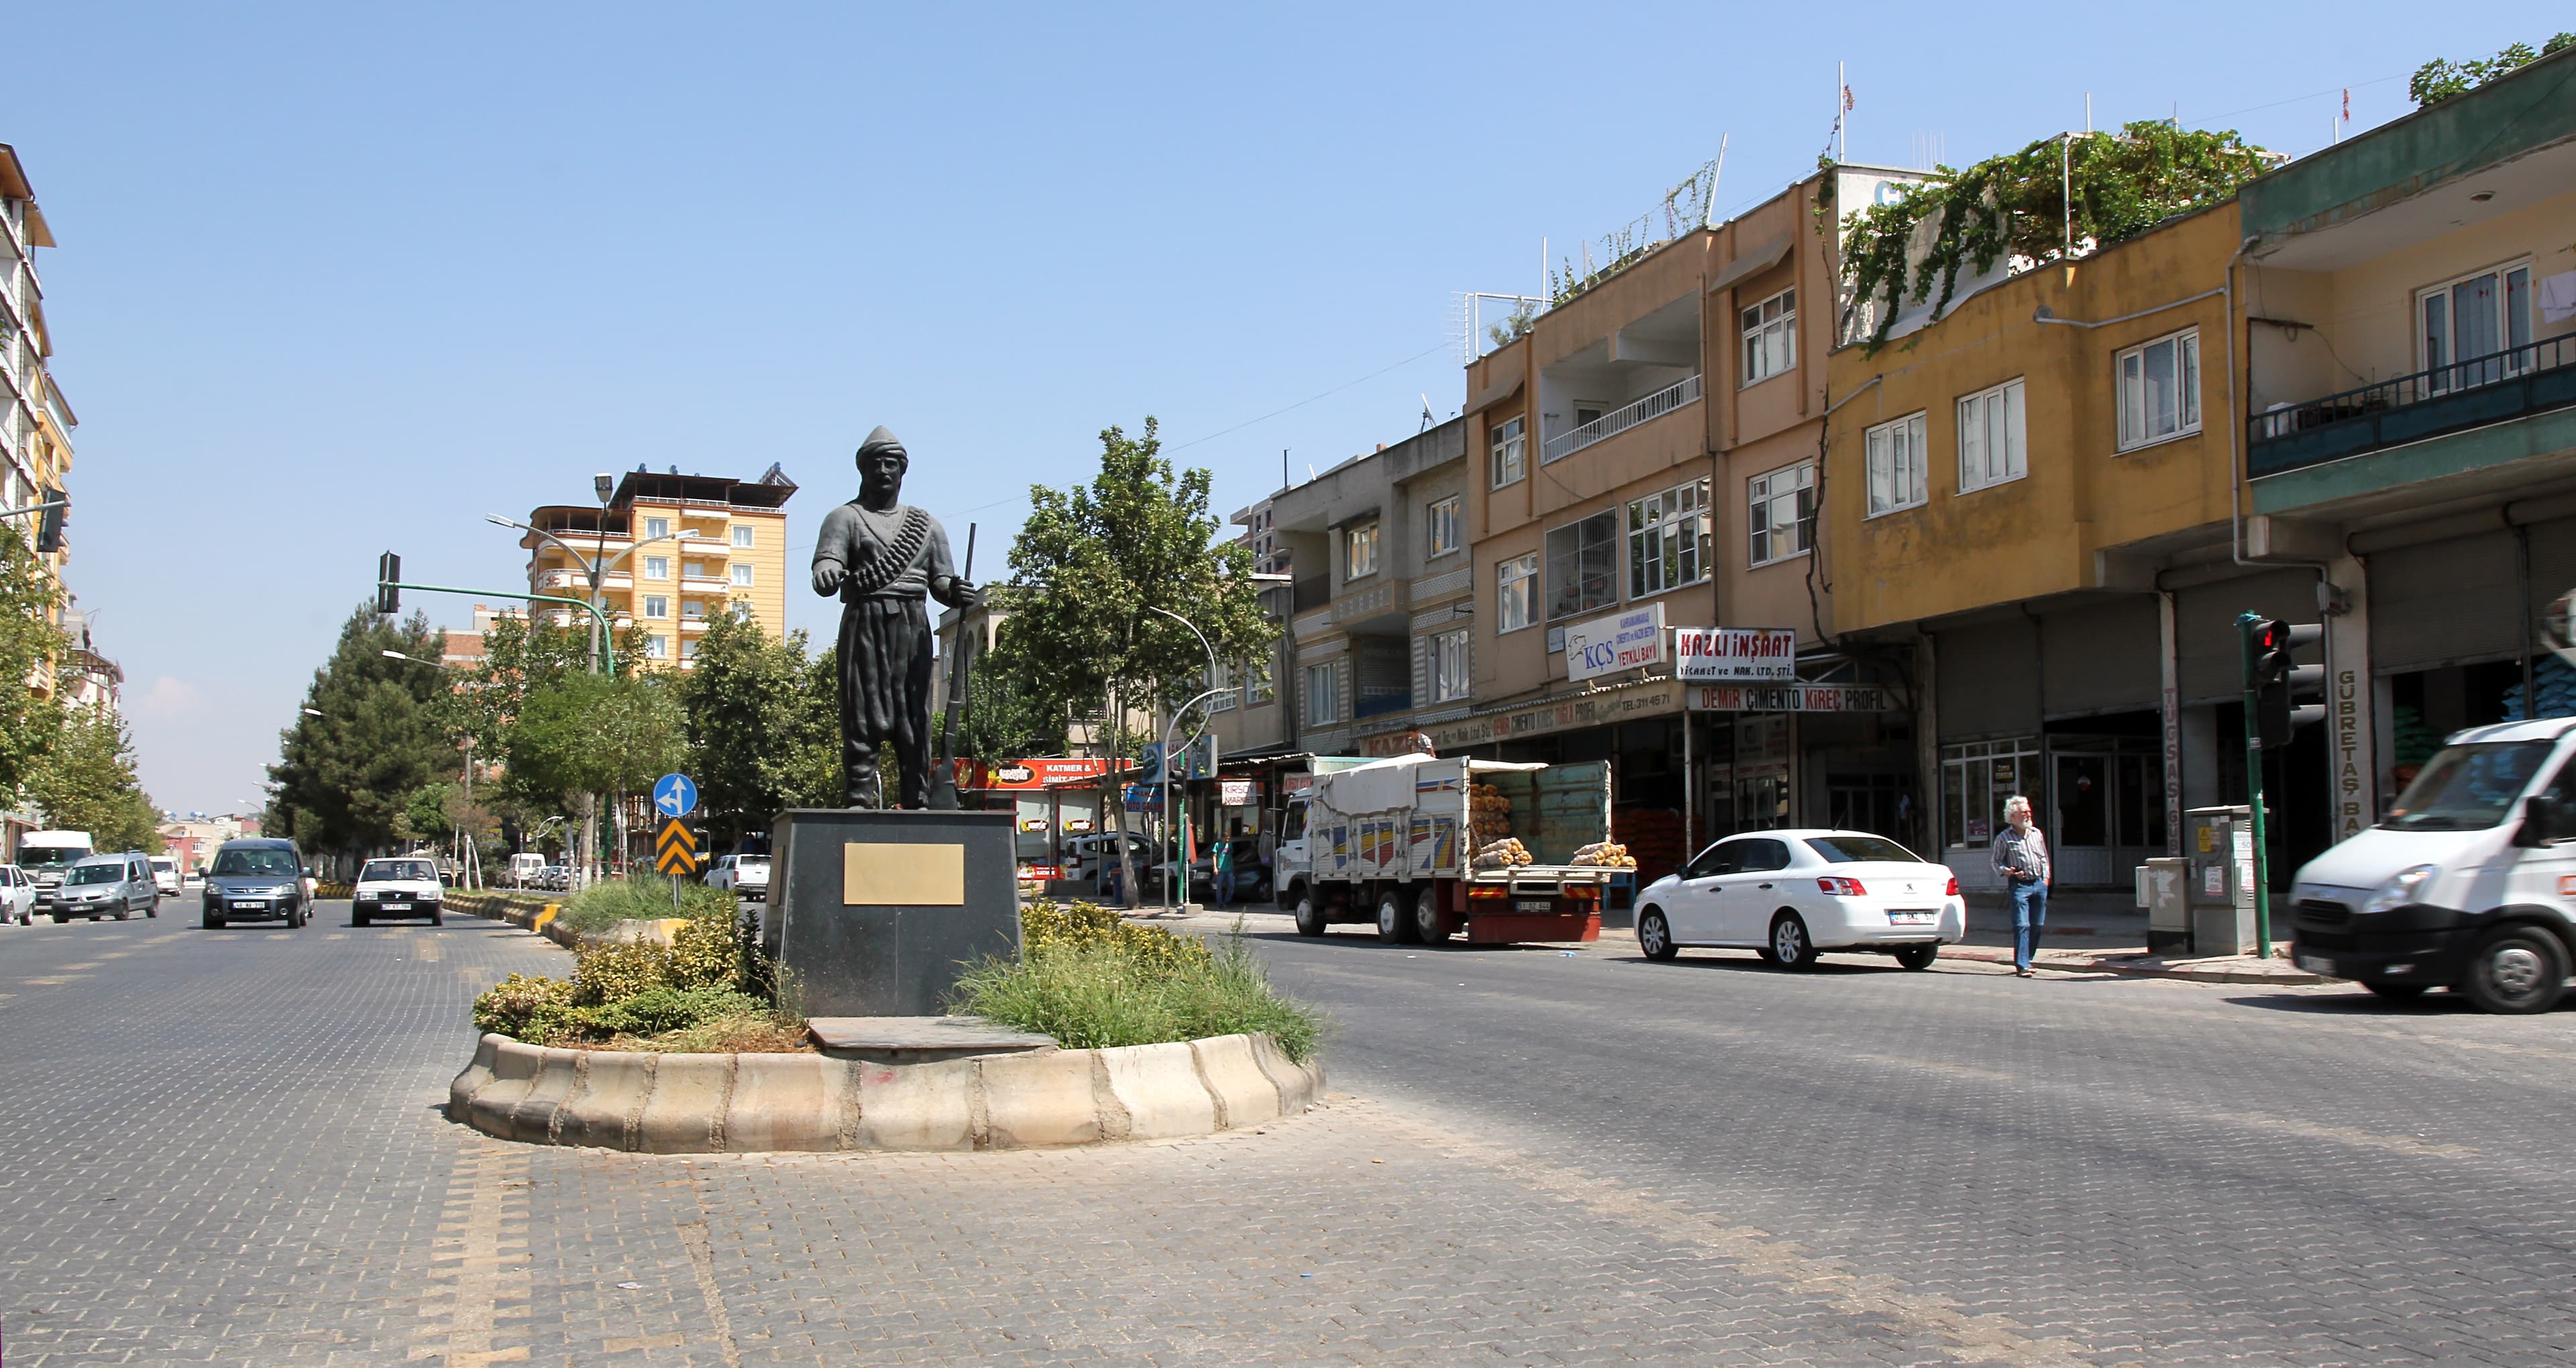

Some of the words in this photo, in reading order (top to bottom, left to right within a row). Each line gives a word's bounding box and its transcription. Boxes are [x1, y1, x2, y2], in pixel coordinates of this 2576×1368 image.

[1585, 640, 1614, 672] KÇS
[1680, 633, 1729, 657] KAZLI
[2339, 670, 2360, 796] GÜBRETAŞ
